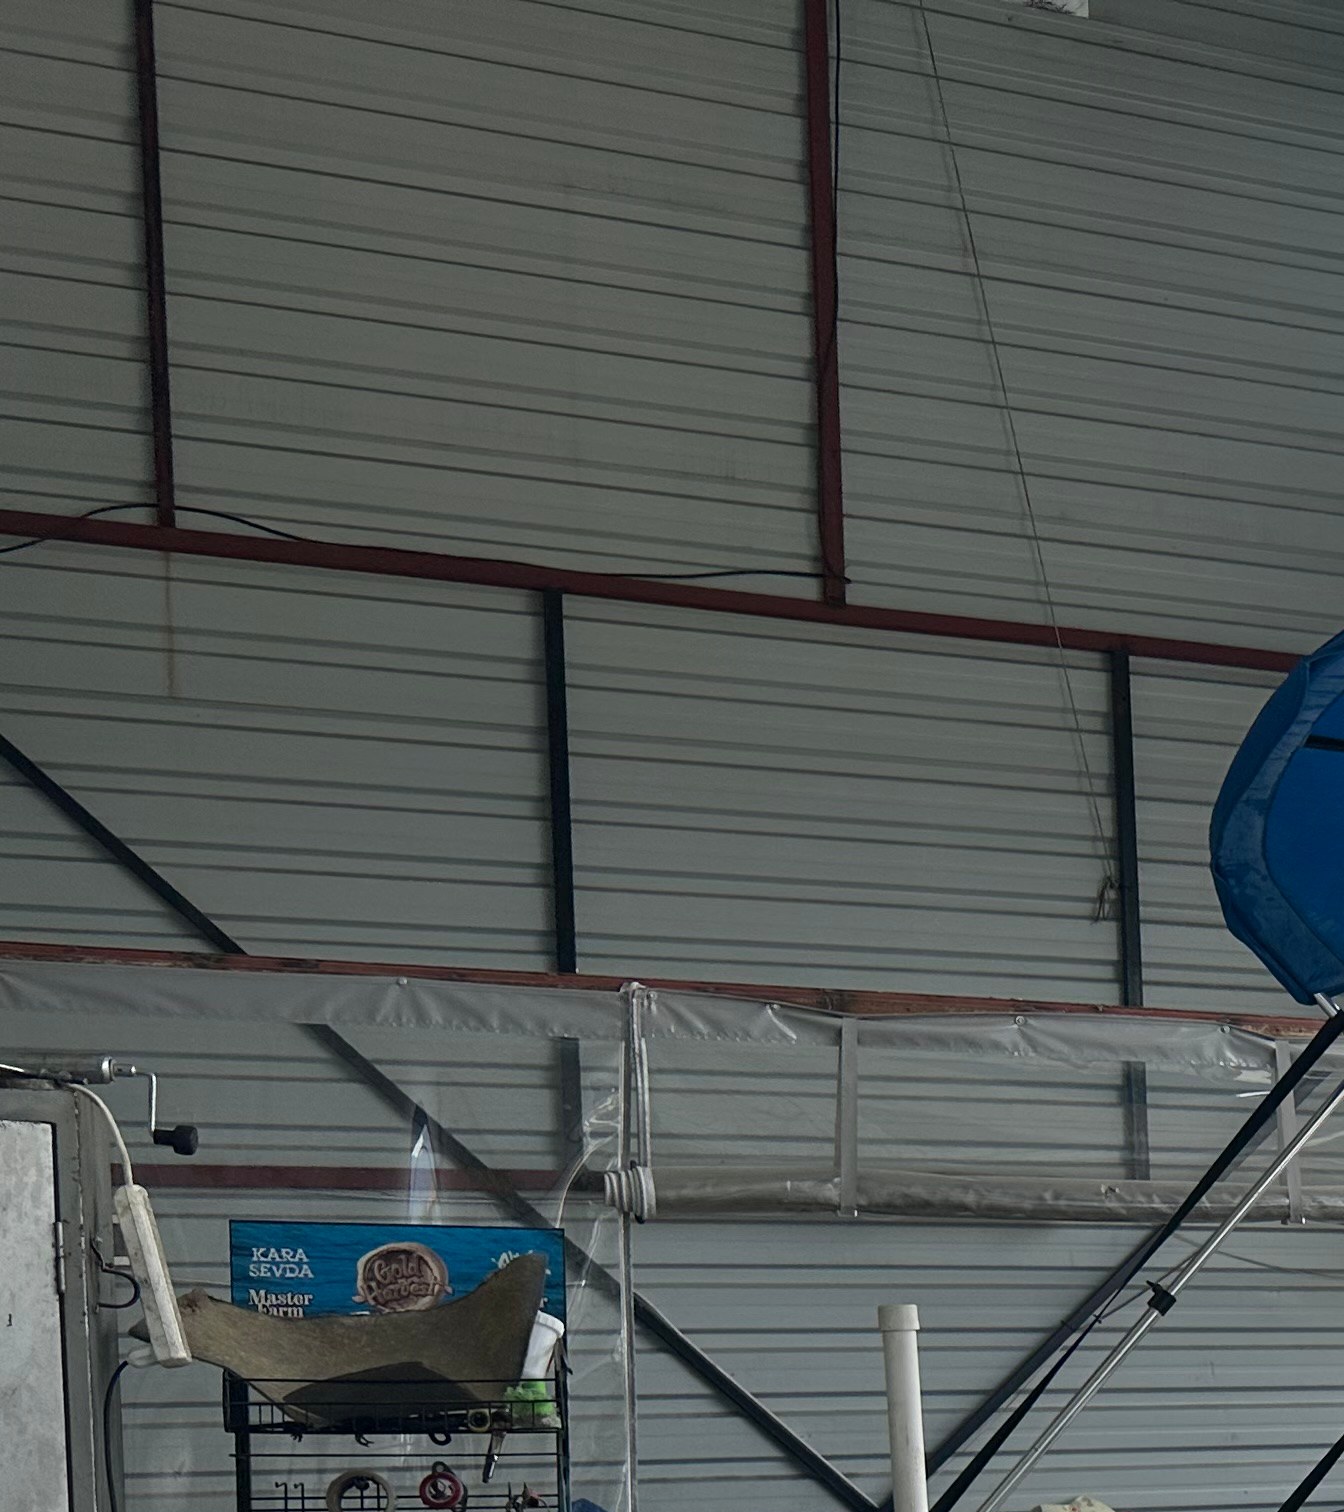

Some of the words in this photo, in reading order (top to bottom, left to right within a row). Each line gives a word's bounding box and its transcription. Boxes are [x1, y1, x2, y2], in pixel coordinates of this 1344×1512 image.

[252, 1247, 309, 1262] KARA
[249, 1263, 314, 1278] SEVDA
[374, 1253, 423, 1283] Gold
[248, 1288, 313, 1305] Master
